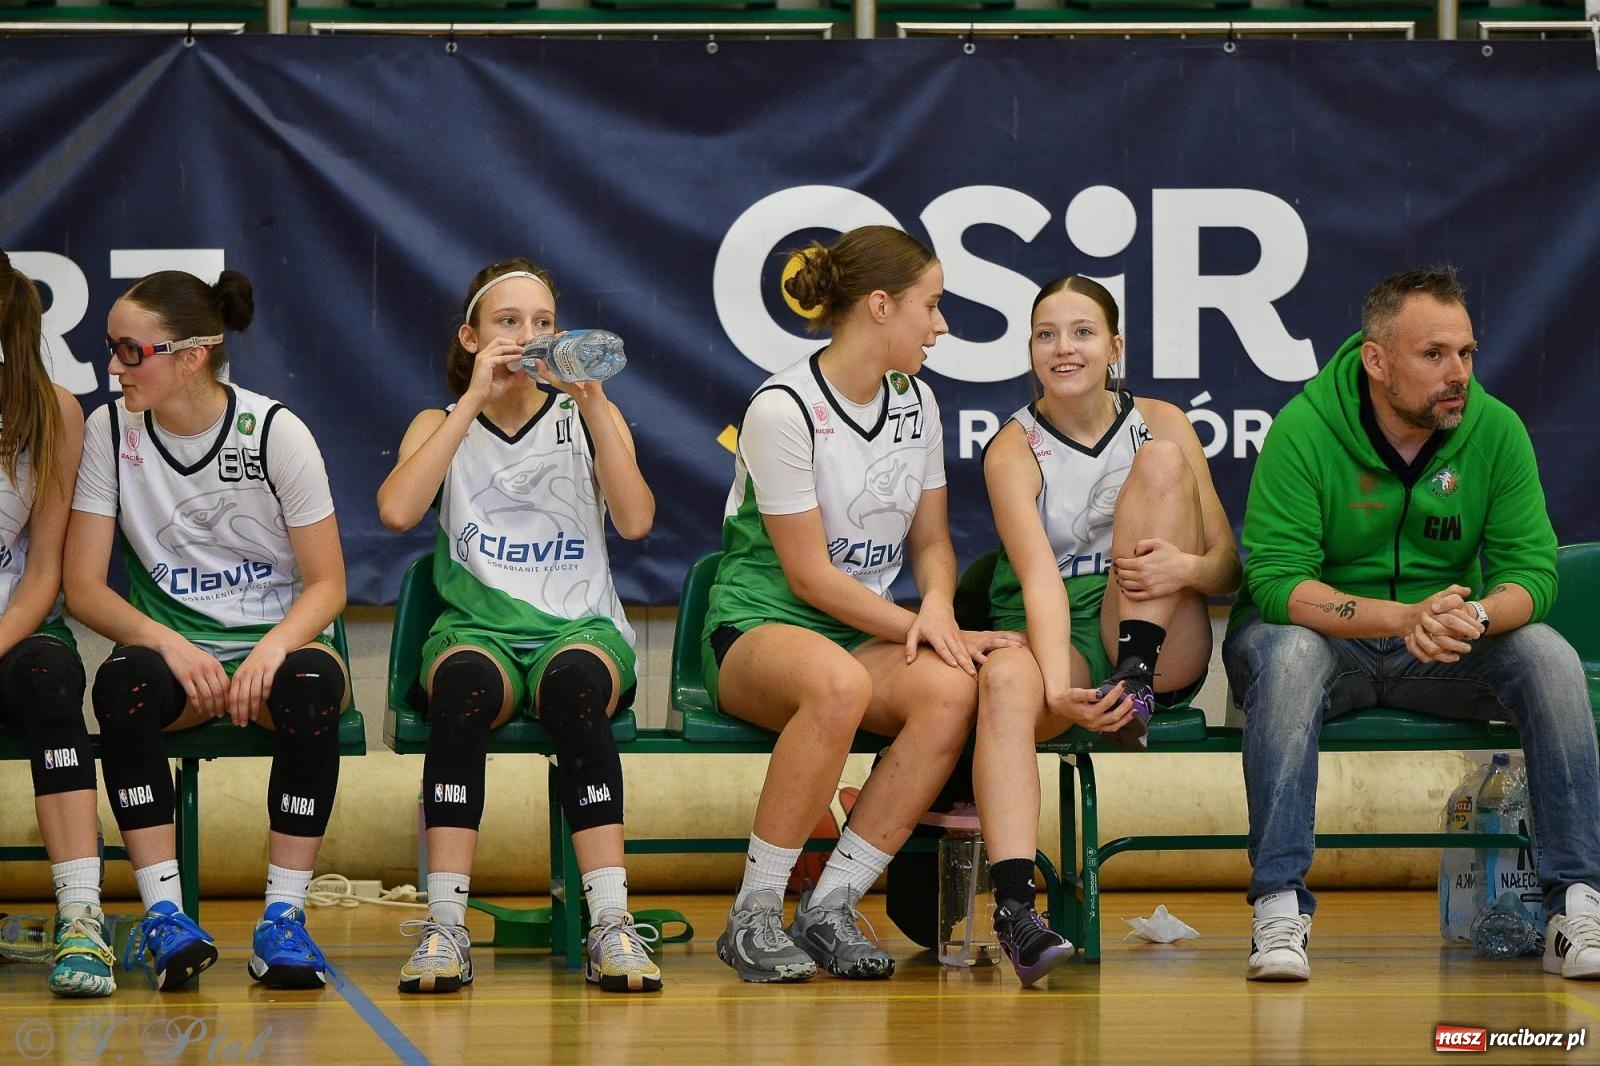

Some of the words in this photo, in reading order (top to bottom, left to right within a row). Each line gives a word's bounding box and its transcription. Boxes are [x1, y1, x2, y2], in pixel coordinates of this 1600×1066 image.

[713, 184, 1318, 384] OSiR
[888, 403, 923, 443] 77
[218, 447, 265, 482] 85
[1424, 513, 1462, 541] GW
[480, 532, 584, 562] Clavis
[843, 539, 902, 568] Clav
[170, 558, 272, 595] Clavis
[54, 748, 79, 768] NBA
[128, 785, 154, 807] NBA
[290, 796, 315, 816] NBA
[444, 784, 467, 803] NBA
[587, 783, 611, 803] NBA
